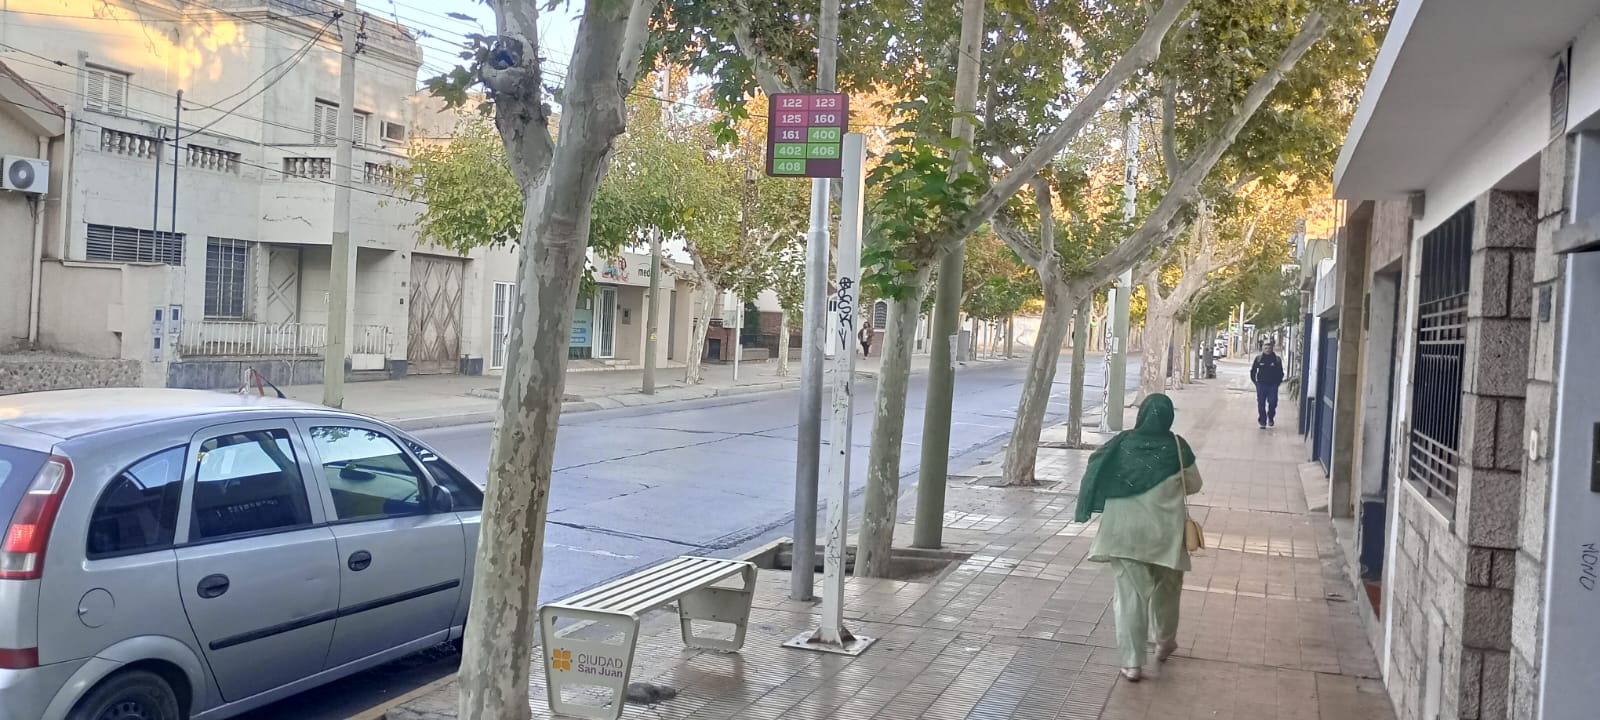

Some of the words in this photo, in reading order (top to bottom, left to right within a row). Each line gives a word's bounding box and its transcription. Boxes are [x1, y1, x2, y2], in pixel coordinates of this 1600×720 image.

[782, 98, 802, 108] 122
[815, 98, 835, 108] 123
[782, 114, 801, 123] 125
[815, 114, 835, 123] 160
[782, 130, 799, 139] 161
[812, 130, 835, 139] 400
[780, 146, 802, 155] 402
[812, 146, 834, 155] 406
[778, 162, 800, 171] 408
[577, 653, 623, 669] CIUDAD
[577, 664, 597, 675] San
[598, 666, 623, 678] Juan
